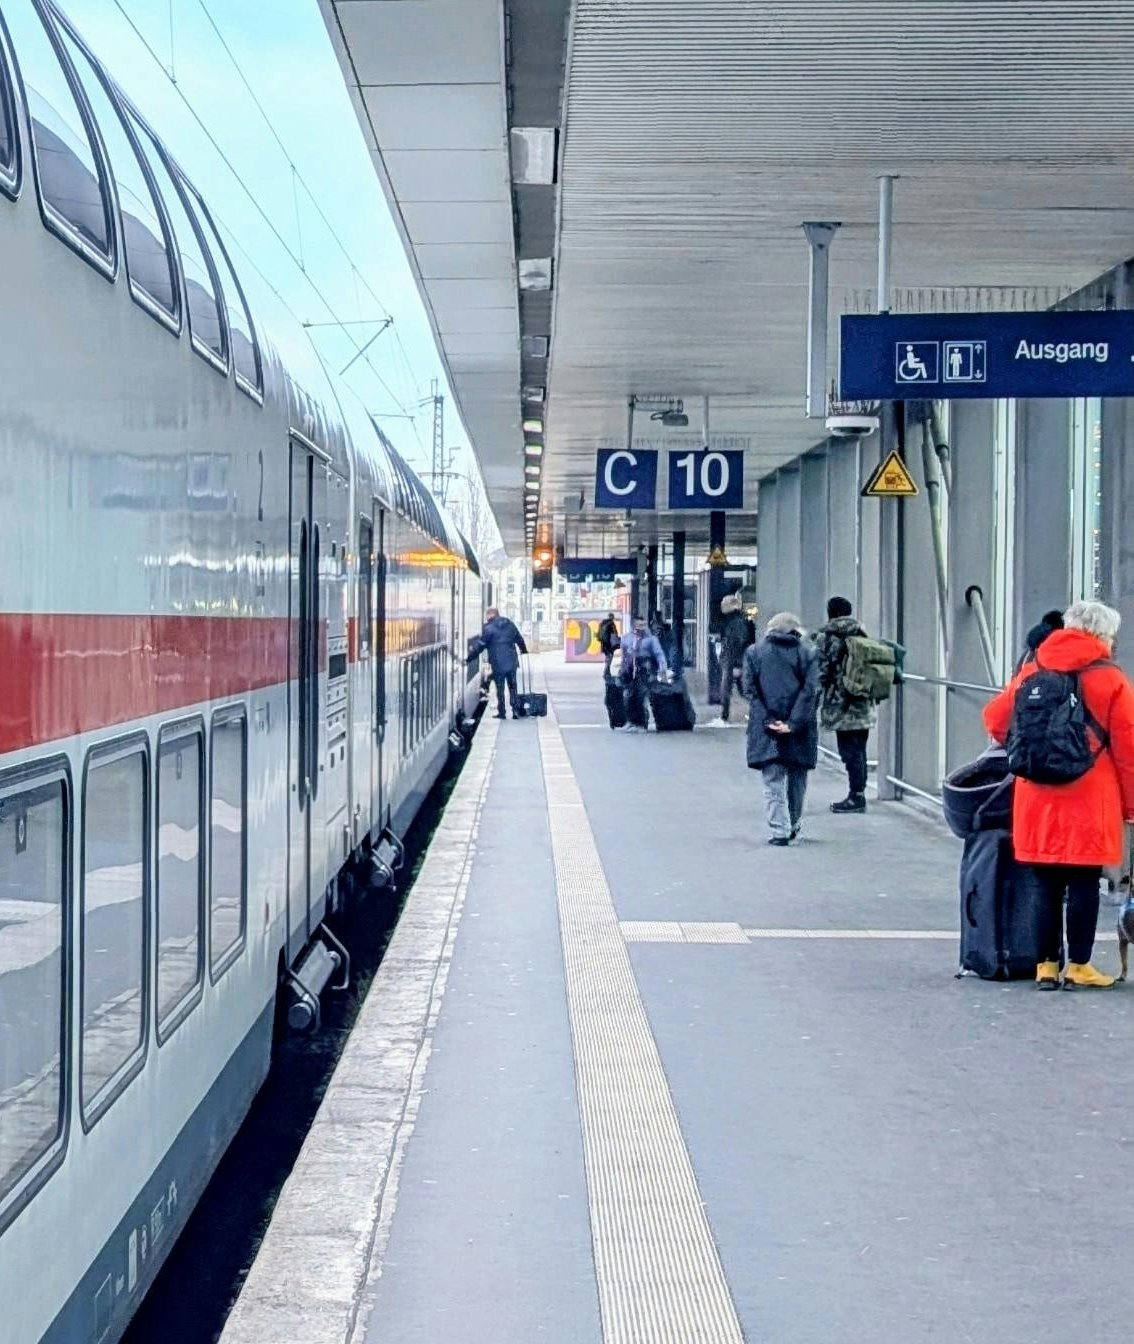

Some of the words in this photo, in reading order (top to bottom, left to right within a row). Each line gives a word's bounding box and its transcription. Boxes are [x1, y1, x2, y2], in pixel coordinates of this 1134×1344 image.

[1014, 339, 1109, 363] Ausgang
[604, 451, 637, 496] C
[676, 452, 730, 496] 10
